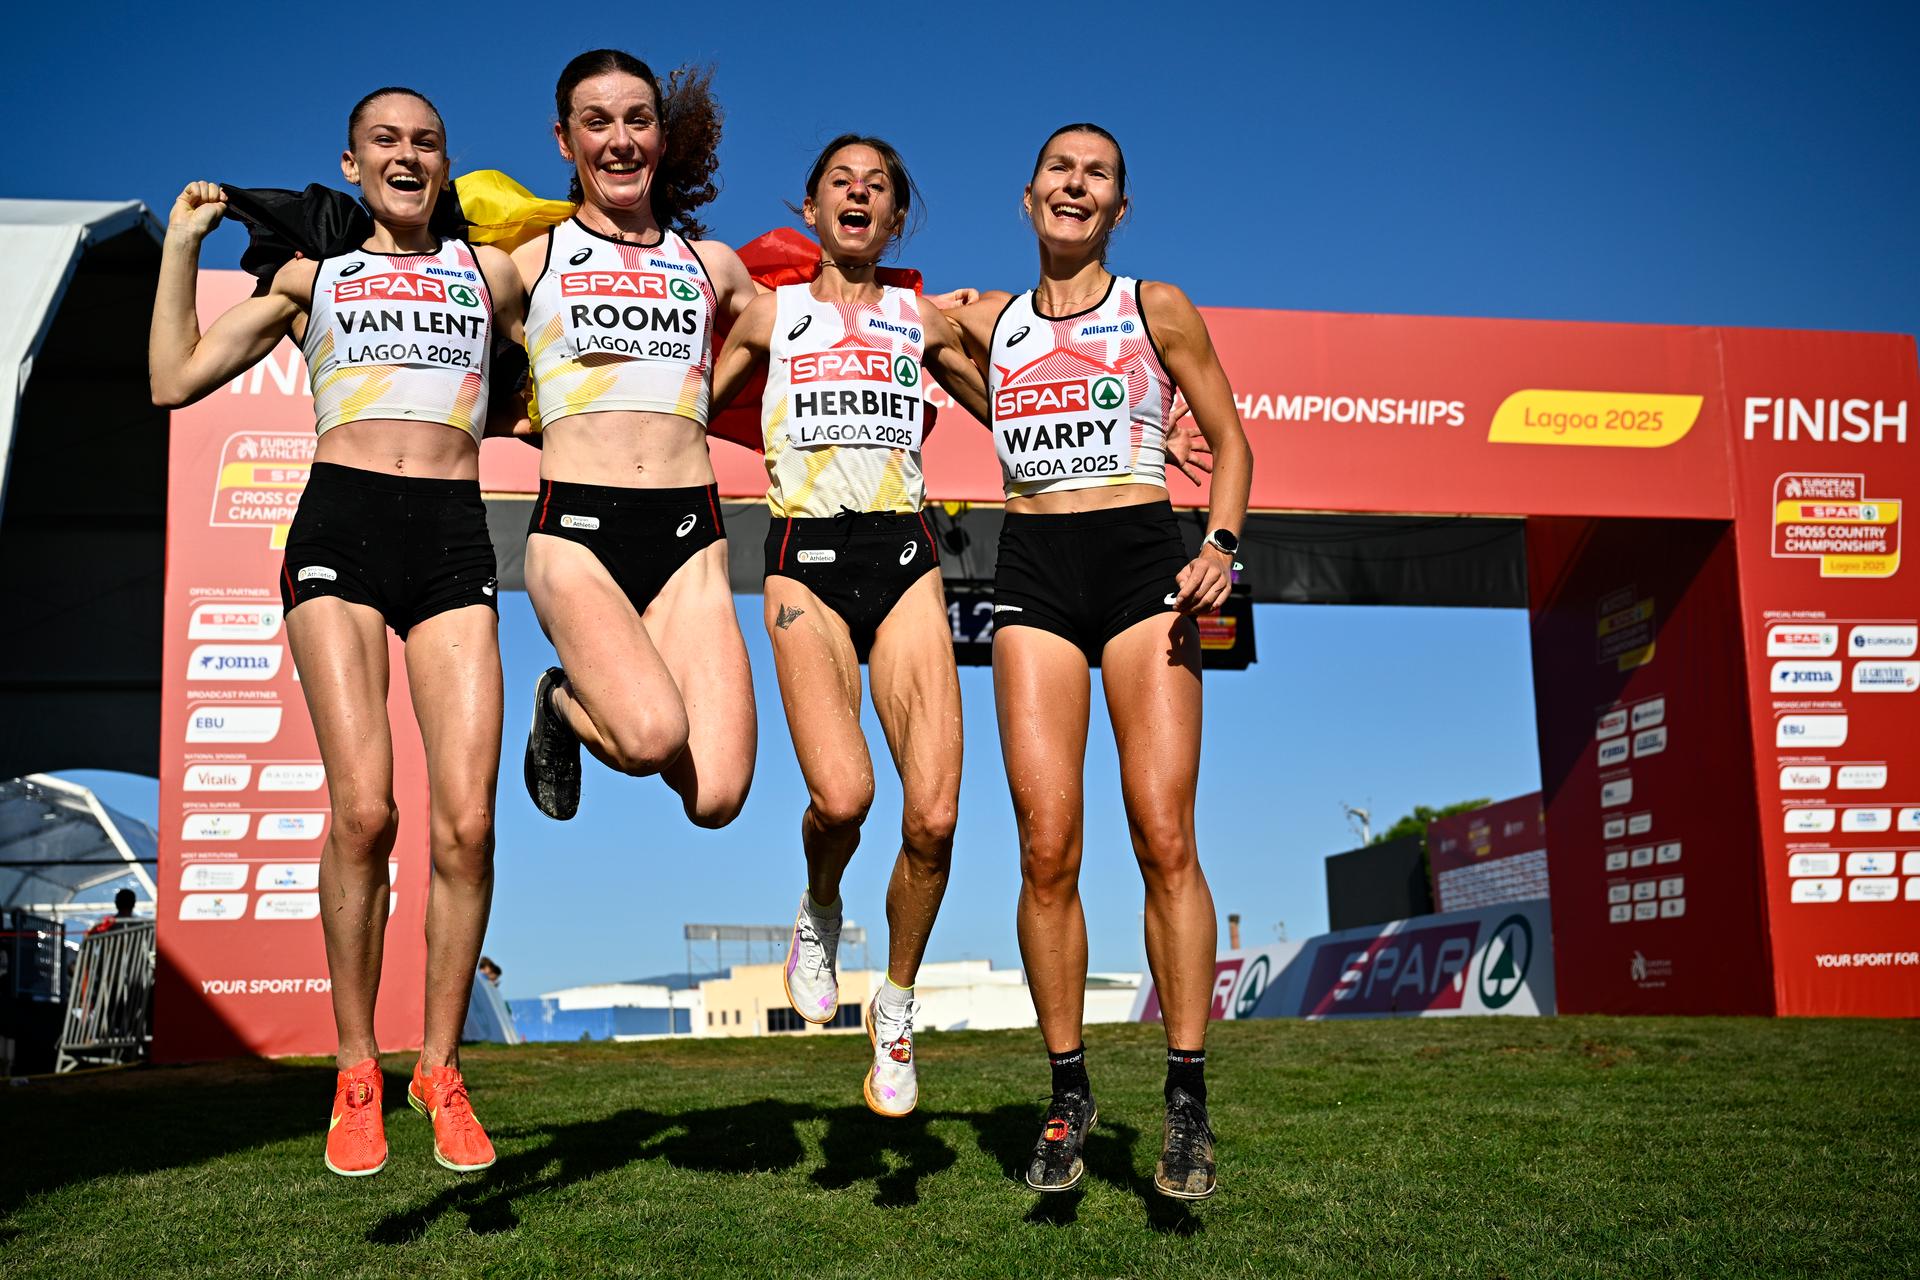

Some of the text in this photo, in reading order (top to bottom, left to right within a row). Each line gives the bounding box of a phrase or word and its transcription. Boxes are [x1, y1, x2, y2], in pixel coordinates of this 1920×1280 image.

[650, 258, 684, 271] Allianz
[426, 267, 462, 278] Allianz
[338, 276, 444, 299] SPAR
[564, 275, 664, 295] SPAR
[336, 310, 484, 340] VAN LENT
[570, 304, 697, 335] ROOMS
[868, 318, 908, 336] Allianz
[1080, 324, 1118, 336] Allianz
[576, 334, 691, 360] LAGOA 2025
[348, 344, 471, 368] LAGOA 2025
[794, 354, 889, 380] SPAR
[795, 390, 920, 422] HERBIET
[997, 384, 1086, 416] SPAR
[1233, 394, 1465, 427] HAMPIONSHIPS
[1524, 407, 1664, 435] Lagoa 2025
[1744, 397, 1908, 443] FINISH
[801, 424, 912, 446] LAGOA 2025
[1003, 418, 1118, 454] WARPY
[260, 438, 318, 449] EUROPEA
[260, 448, 316, 460] ATHLETI
[1071, 455, 1118, 474] 2025
[271, 470, 310, 482] SPA
[1802, 478, 1855, 488] EUROPEAN
[231, 491, 283, 505] CROSS
[1803, 488, 1856, 498] ATHLETICS
[1813, 506, 1860, 518] SPAR
[1785, 525, 1887, 539] CROSS COUNTRY
[1784, 539, 1887, 552] CHAMPIONSHIPS
[190, 588, 270, 597] OFFICIAL PARTNERS
[213, 614, 258, 624] SPAR
[187, 690, 278, 699] BROADCAST PARTNER
[196, 717, 224, 729] EBU
[198, 773, 238, 786] Vitalis
[266, 772, 320, 780] RADIANT
[1790, 773, 1821, 784] Vitalis
[1816, 953, 1919, 968] YOUR SPORT FOR
[1333, 936, 1471, 1000] SPAR
[201, 980, 246, 994] YOUR
[250, 979, 304, 994] SPORT
